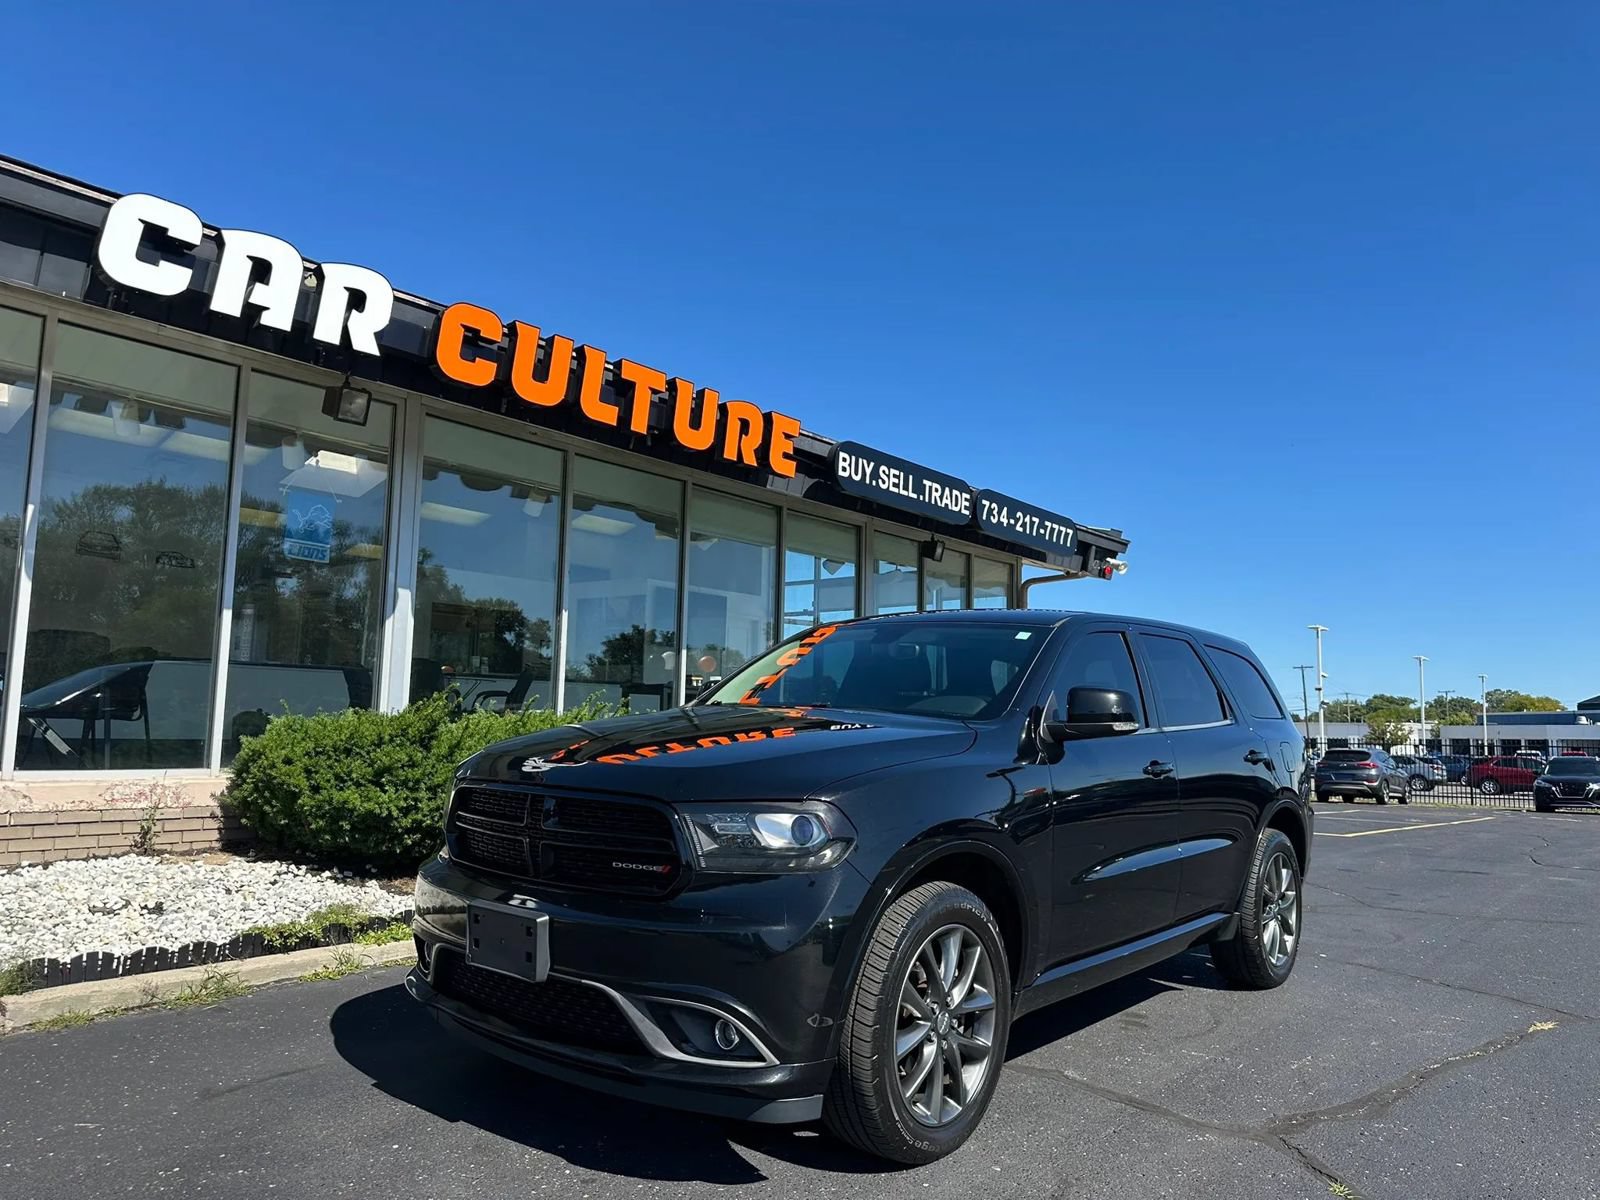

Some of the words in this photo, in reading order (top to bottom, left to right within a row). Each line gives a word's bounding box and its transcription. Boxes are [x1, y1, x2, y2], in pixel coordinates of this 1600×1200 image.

[98, 192, 394, 357] CAR
[436, 302, 801, 478] CULTURE
[982, 499, 1074, 547] 734-217-7777
[612, 862, 663, 872] DODGE
